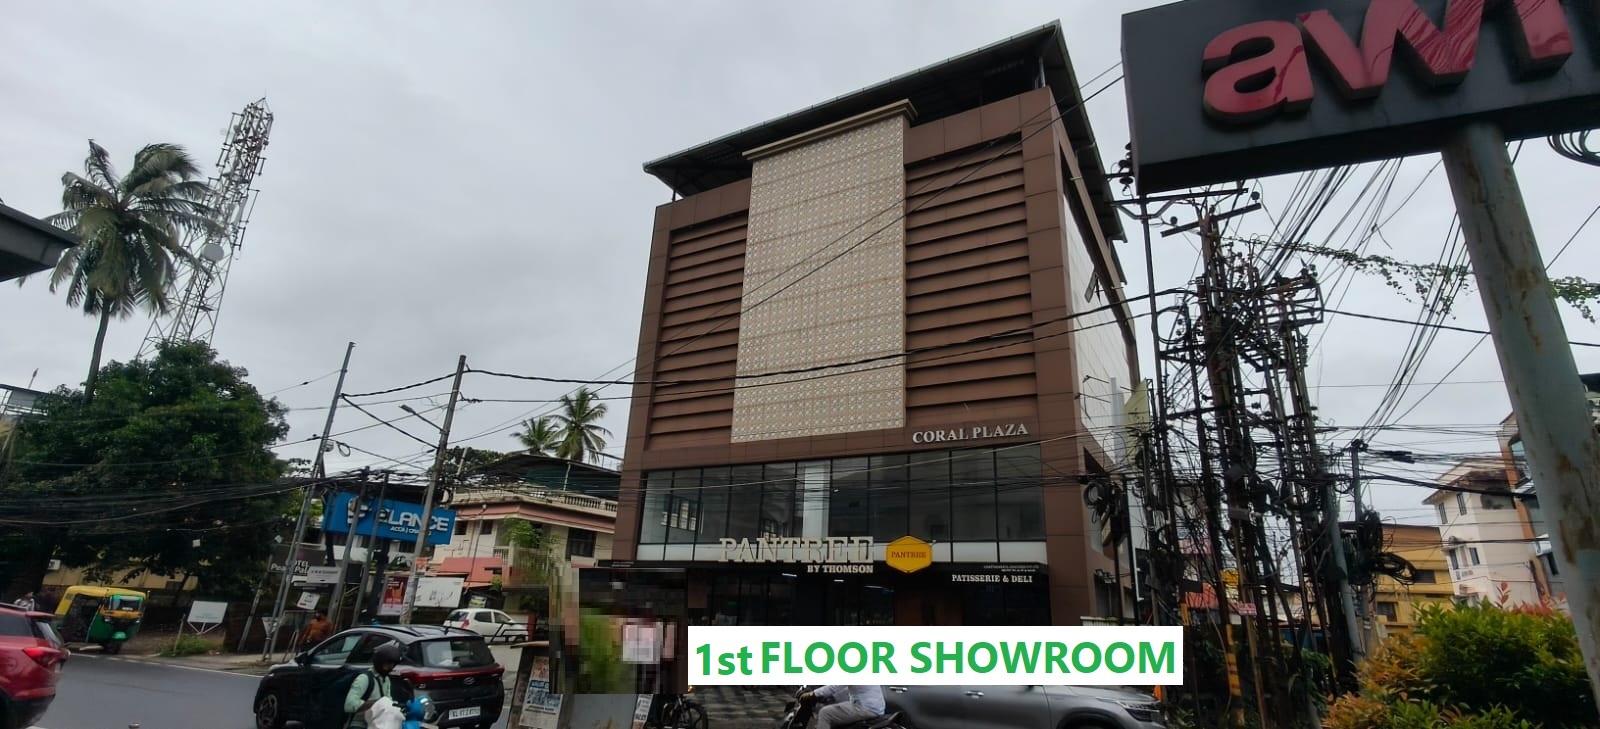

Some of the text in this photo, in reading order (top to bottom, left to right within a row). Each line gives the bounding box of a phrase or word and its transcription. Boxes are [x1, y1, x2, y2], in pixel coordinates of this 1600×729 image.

[912, 423, 1028, 443] CORAL PLAZA
[718, 536, 874, 564] PANTREE
[807, 565, 874, 573] BY THOMSON
[952, 574, 1033, 583] PATISSERIE & DELI
